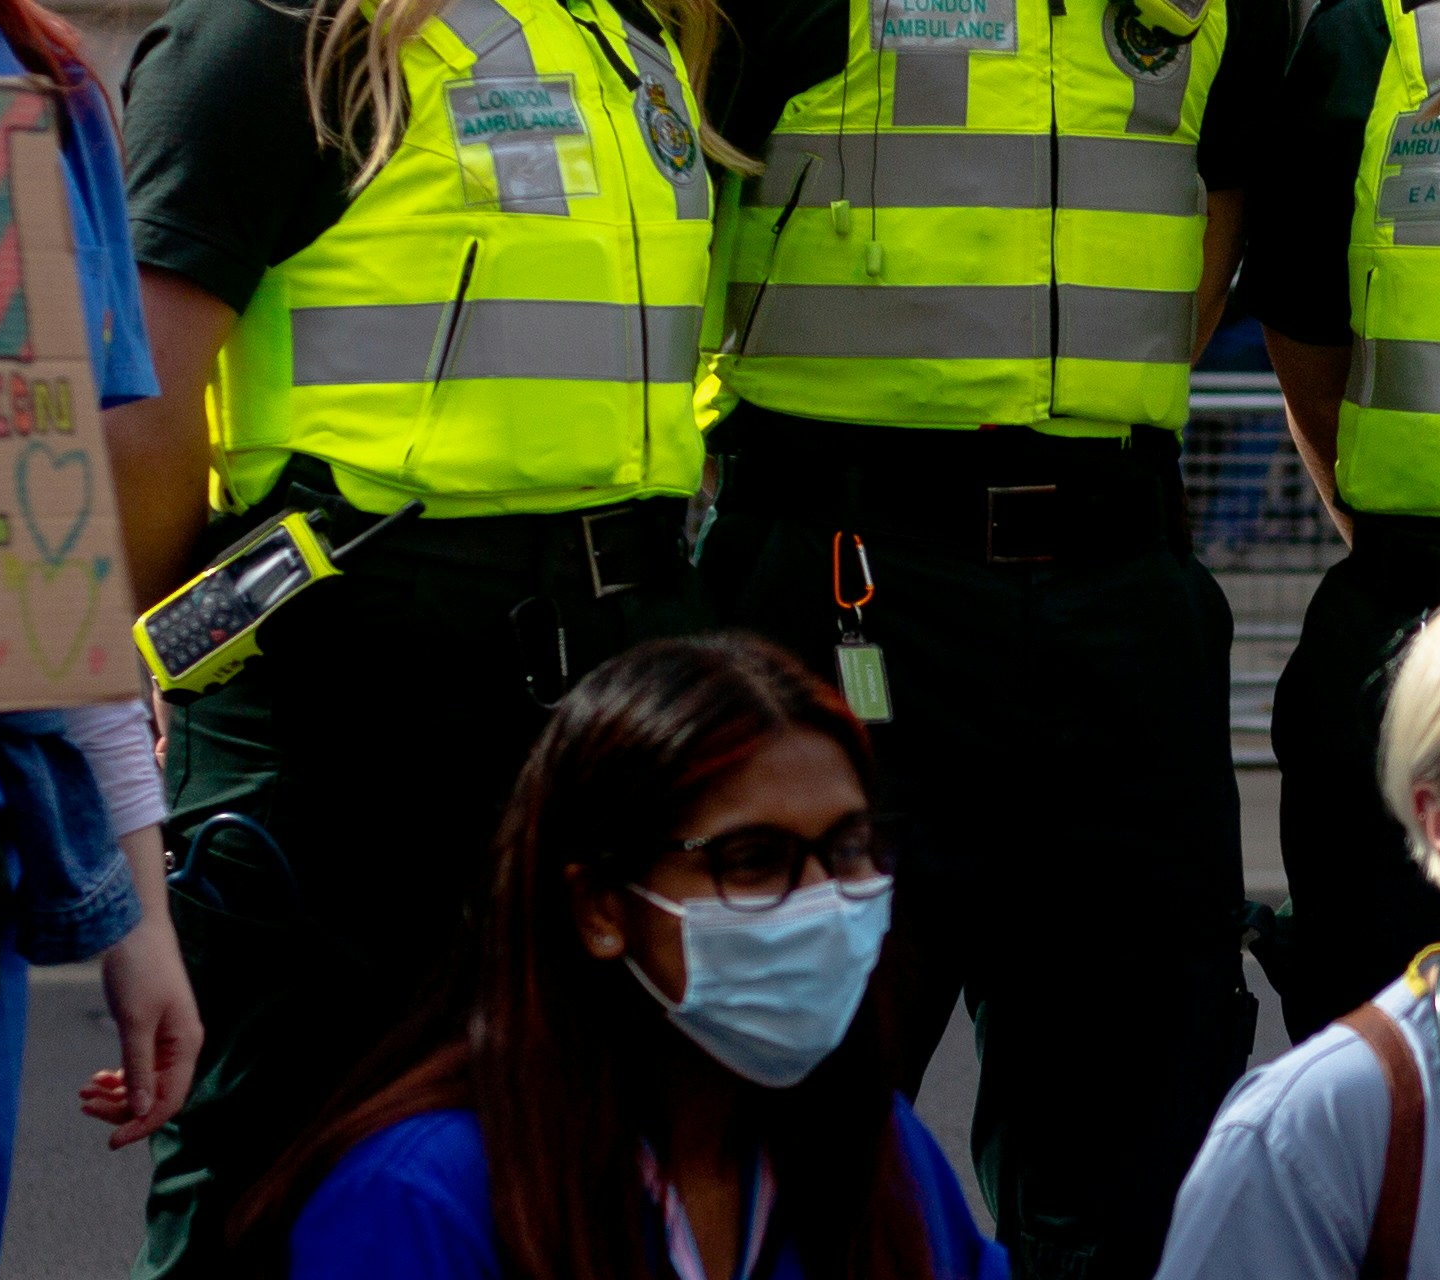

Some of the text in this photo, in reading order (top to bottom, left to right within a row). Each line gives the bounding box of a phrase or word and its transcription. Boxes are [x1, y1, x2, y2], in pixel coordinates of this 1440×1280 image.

[883, 19, 1006, 42] AMBULANCE
[476, 88, 553, 111] LONDON
[463, 108, 578, 136] AMBULANCE
